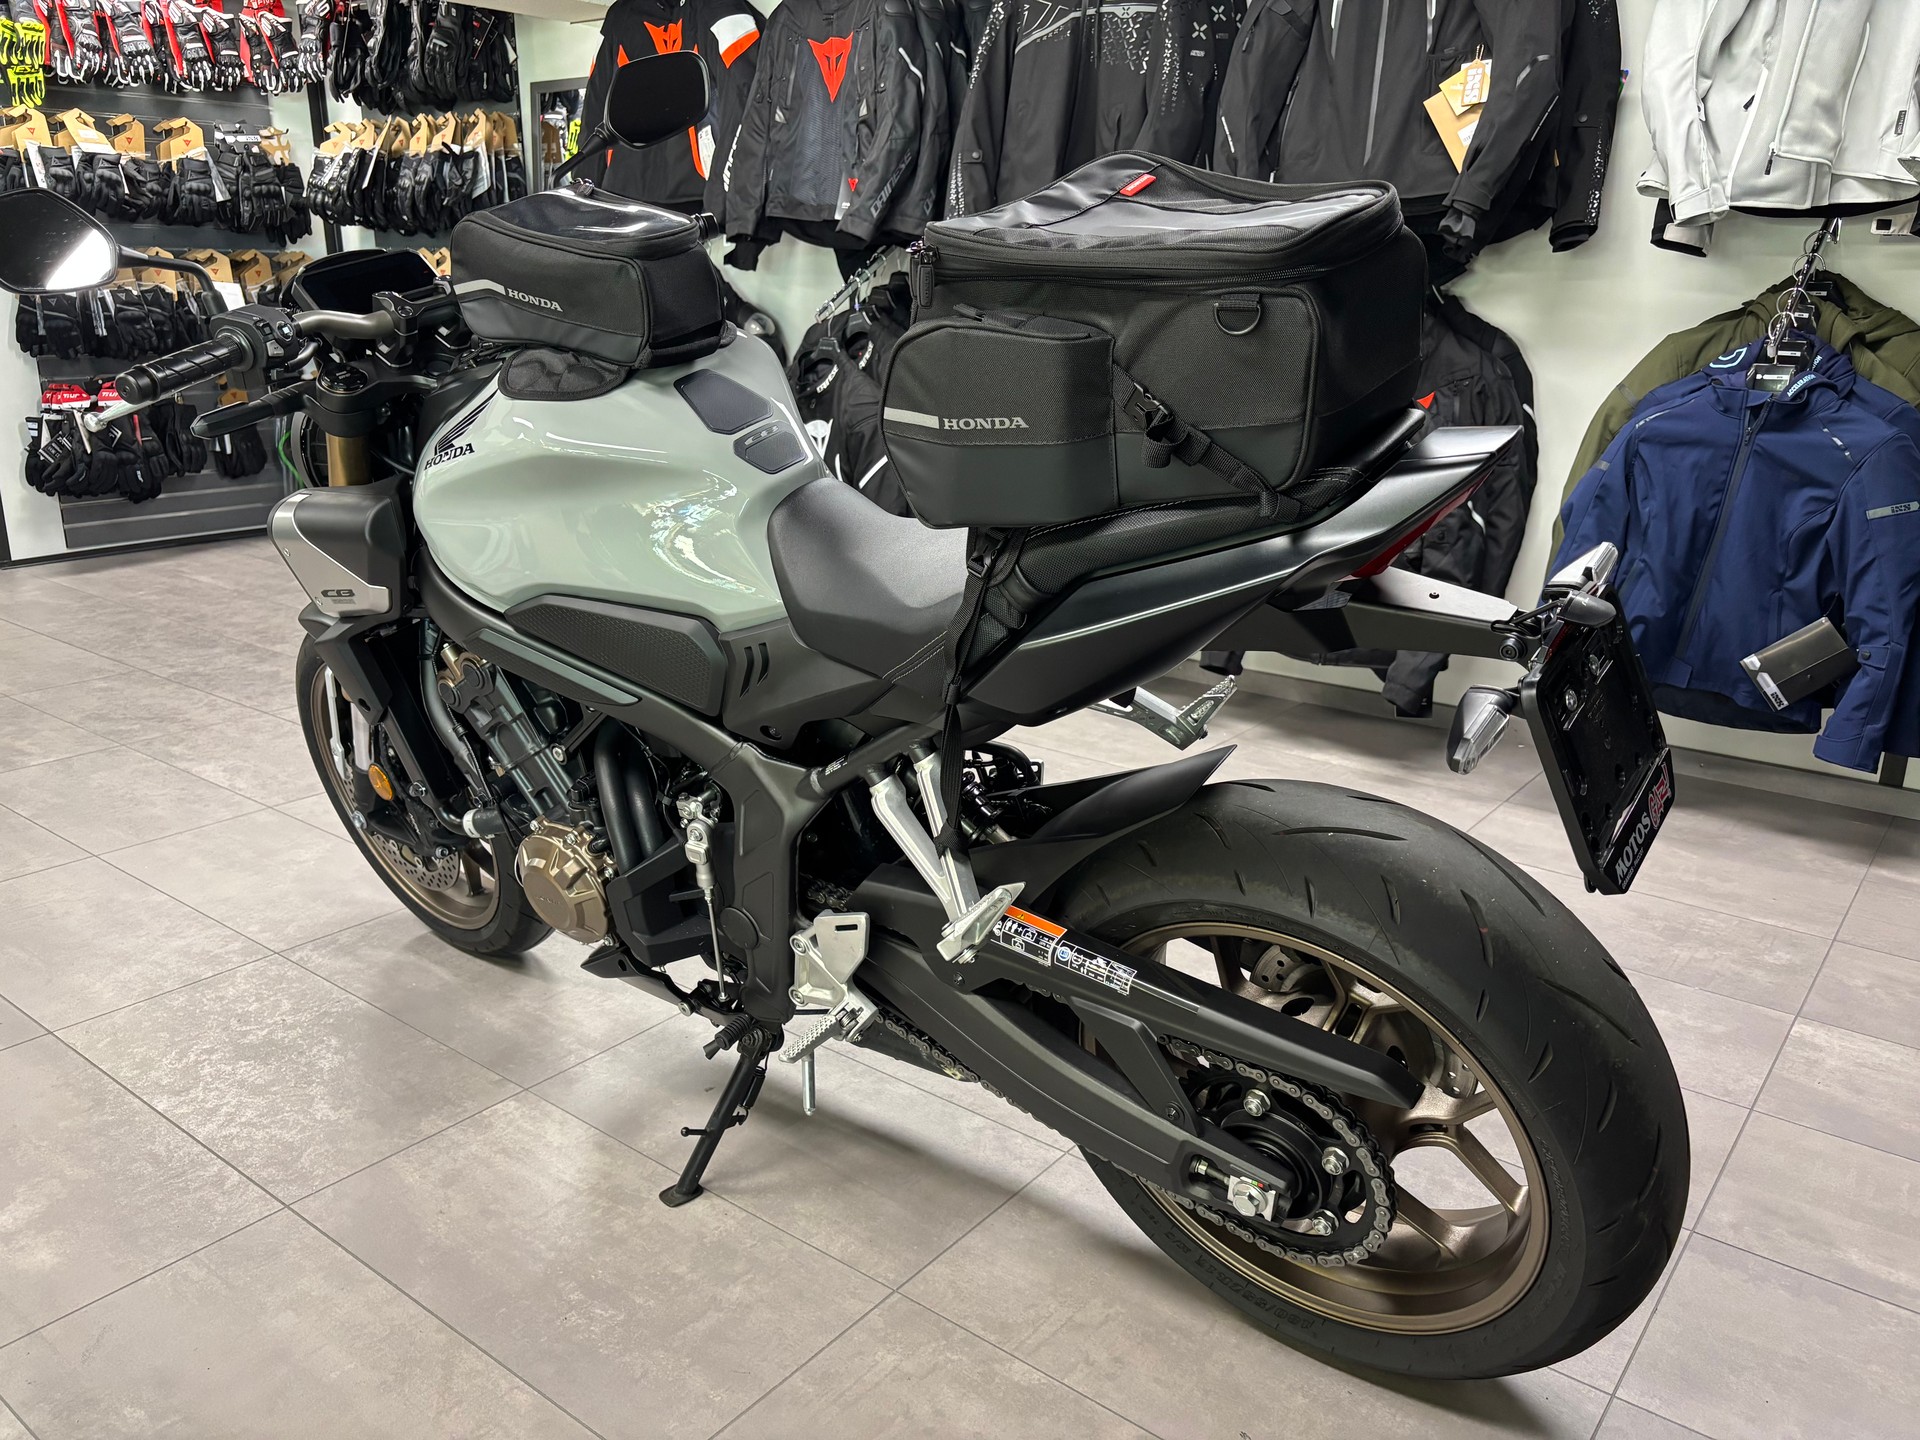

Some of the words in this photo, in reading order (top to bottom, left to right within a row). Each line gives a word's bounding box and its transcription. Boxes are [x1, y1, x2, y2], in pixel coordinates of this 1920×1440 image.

[870, 150, 912, 218] DAINESE
[507, 287, 563, 312] HONDA
[943, 417, 1029, 430] HONDA
[424, 443, 475, 471] HONDA
[1615, 812, 1650, 885] MOTOS
